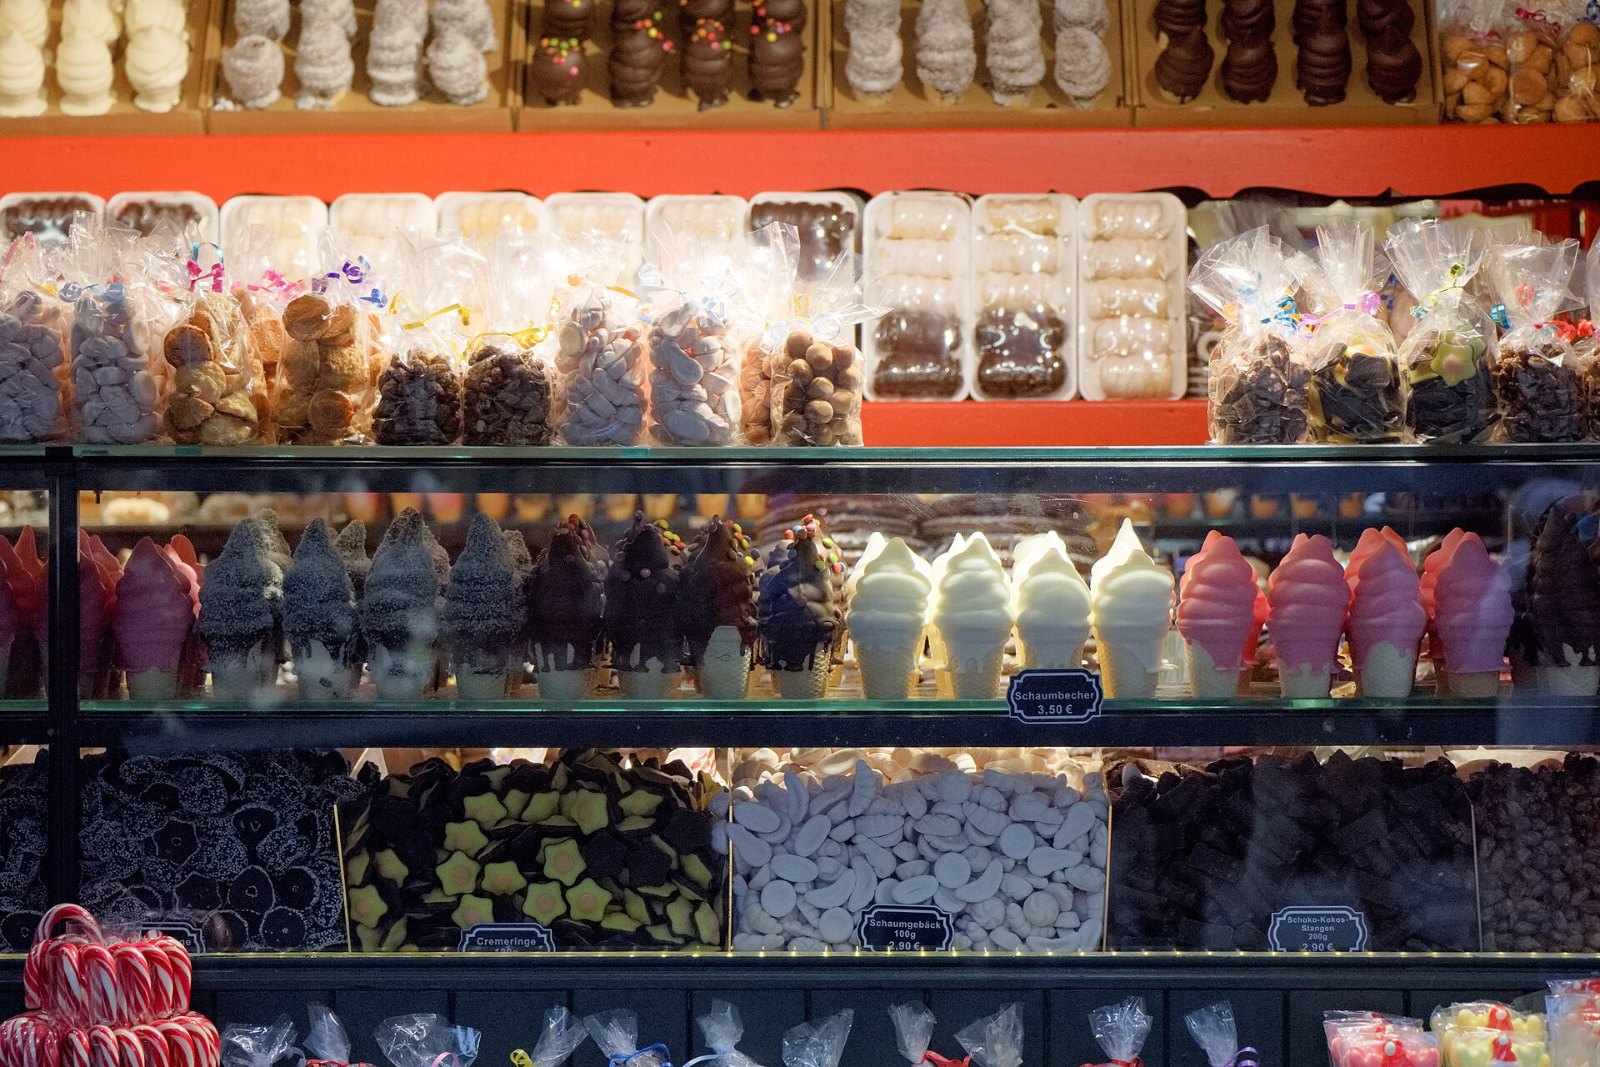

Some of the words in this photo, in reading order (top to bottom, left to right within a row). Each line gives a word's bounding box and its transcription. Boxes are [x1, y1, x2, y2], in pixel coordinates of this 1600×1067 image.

[1014, 691, 1095, 701] Schaumbecher
[1037, 704, 1063, 716] 3,50
[1065, 704, 1073, 714] €
[869, 919, 941, 930] Schaumgebäck
[1287, 916, 1349, 924] Schoko-Kokos-
[1301, 924, 1335, 932] Stangen
[893, 929, 916, 940] 100g
[1308, 933, 1328, 941] 200g
[476, 937, 537, 948] Cremeringe
[913, 941, 920, 951] €
[1326, 942, 1334, 952] €
